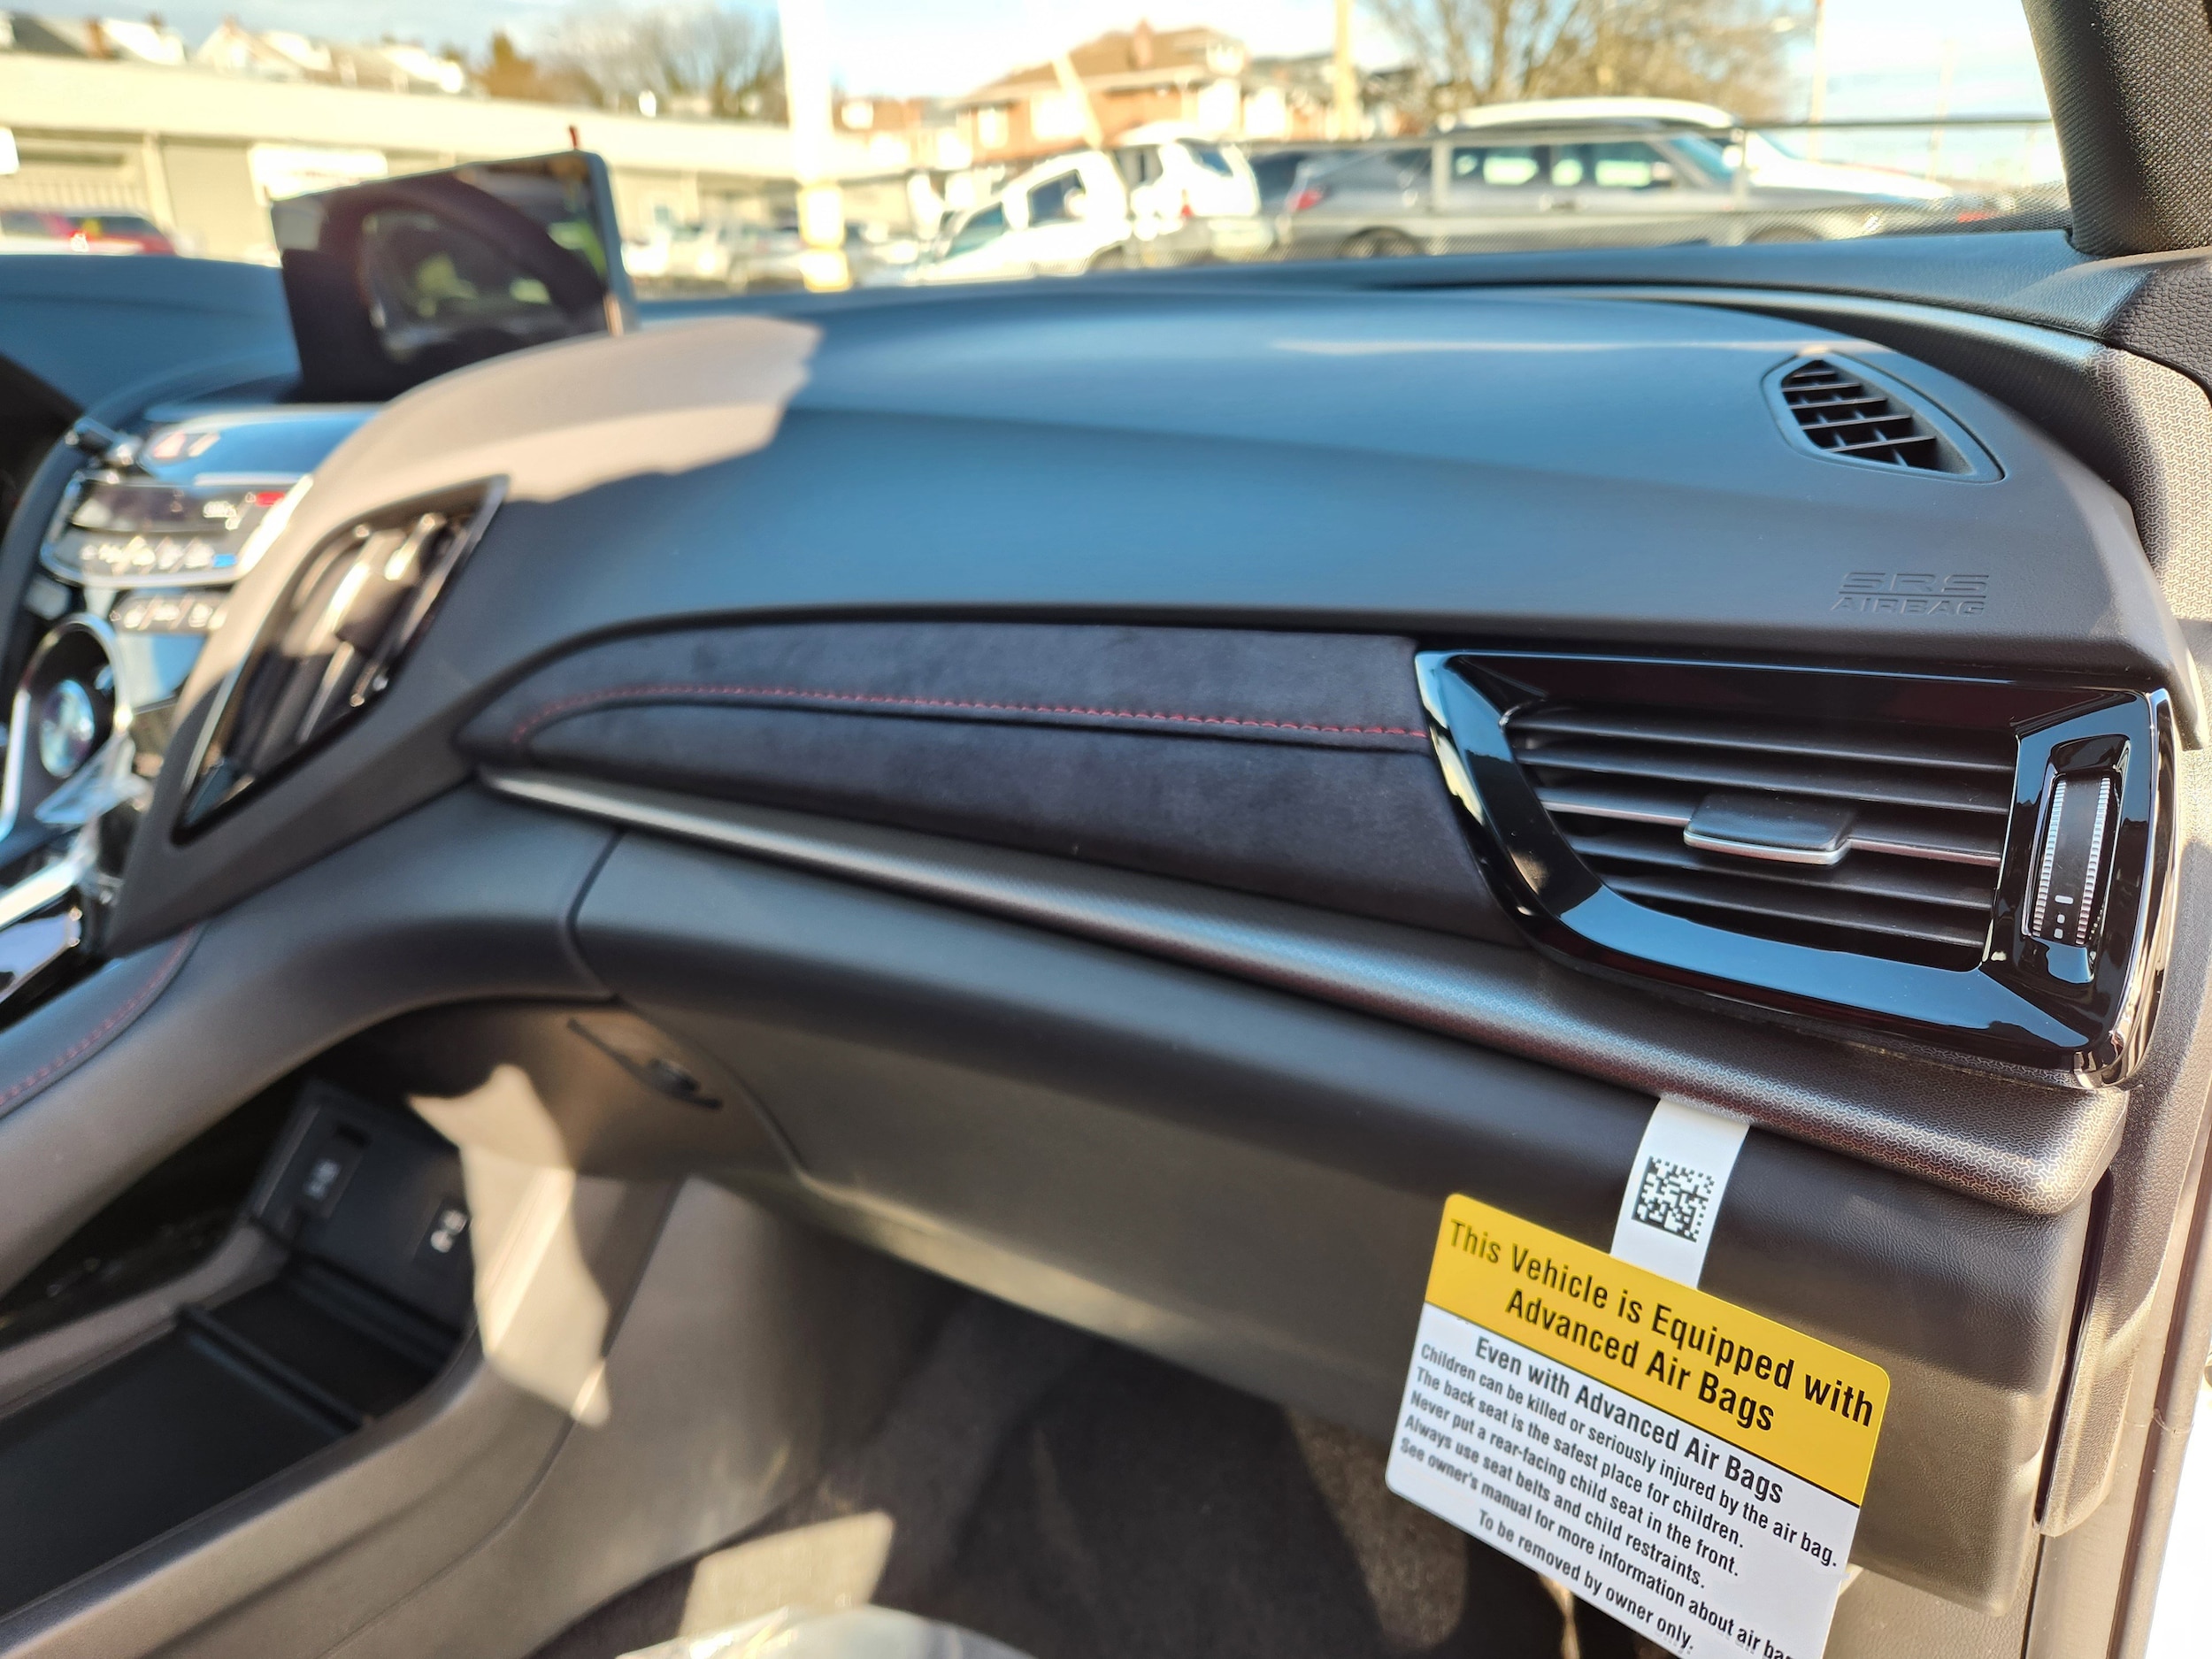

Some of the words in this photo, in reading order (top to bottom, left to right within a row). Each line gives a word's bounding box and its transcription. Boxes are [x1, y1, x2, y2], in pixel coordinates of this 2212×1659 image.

[1830, 597, 1985, 616] AIRBAG
[1842, 572, 1990, 593] SRS
[1450, 1218, 1502, 1263] This
[1513, 1245, 1609, 1310] Vehicle
[1617, 1288, 1643, 1325] is
[1651, 1302, 1795, 1391] Equipped
[1804, 1373, 1873, 1428] with
[1505, 1288, 1640, 1370] Advanced
[1644, 1349, 1692, 1391] Air
[1697, 1370, 1774, 1432] Bags
[1405, 1415, 1452, 1449] Always
[1455, 1443, 1479, 1463] use
[1483, 1456, 1513, 1481] seat
[1515, 1471, 1551, 1502] belts
[1554, 1494, 1582, 1519] and
[1585, 1511, 1623, 1541] child
[1624, 1532, 1705, 1589] restraints.
[1410, 1391, 1450, 1421] Never
[1452, 1414, 1475, 1434] put
[1477, 1427, 1486, 1440] a
[1489, 1433, 1567, 1486] rear-facing
[1570, 1474, 1608, 1504] child
[1609, 1495, 1644, 1525] seat
[1646, 1511, 1663, 1534] in
[1666, 1522, 1692, 1549] the
[1695, 1538, 1739, 1577] front.
[1417, 1367, 1440, 1391] The
[1443, 1380, 1476, 1408] back
[1478, 1400, 1509, 1425] seat
[1511, 1413, 1525, 1432] is
[1527, 1422, 1550, 1446] the
[1553, 1438, 1599, 1471] safest
[1600, 1462, 1643, 1494] place
[1646, 1482, 1671, 1507] for
[1672, 1499, 1744, 1548] children.
[1420, 1343, 1476, 1382] Children
[1479, 1374, 1503, 1395] can
[1506, 1384, 1524, 1405] be
[1526, 1394, 1567, 1426] killed
[1569, 1418, 1586, 1435] or
[1587, 1426, 1657, 1473] seriously
[1659, 1462, 1717, 1502] injured
[1718, 1488, 1740, 1517] by
[1742, 1502, 1769, 1530] the
[1772, 1521, 1798, 1544] air
[1800, 1531, 1837, 1567] bag.
[1475, 1336, 1522, 1376] Even
[1528, 1364, 1570, 1399] with
[1574, 1384, 1680, 1452] Advanced
[1683, 1436, 1721, 1471] Air
[1724, 1454, 1784, 1504] Bags
[1400, 1436, 1425, 1462] See
[1428, 1455, 1479, 1490] owner's
[1481, 1483, 1532, 1520] manual
[1534, 1509, 1555, 1532] for
[1557, 1525, 1595, 1555] more
[1598, 1543, 1686, 1608] information
[1687, 1599, 1735, 1637] about
[1736, 1627, 1762, 1651] air
[1763, 1640, 1793, 1659] ba
[1479, 1509, 1494, 1531] To
[1497, 1520, 1515, 1543] be
[1517, 1535, 1581, 1582] removed
[1583, 1570, 1603, 1597] by
[1605, 1586, 1655, 1624] owner
[1656, 1617, 1694, 1655] only.
